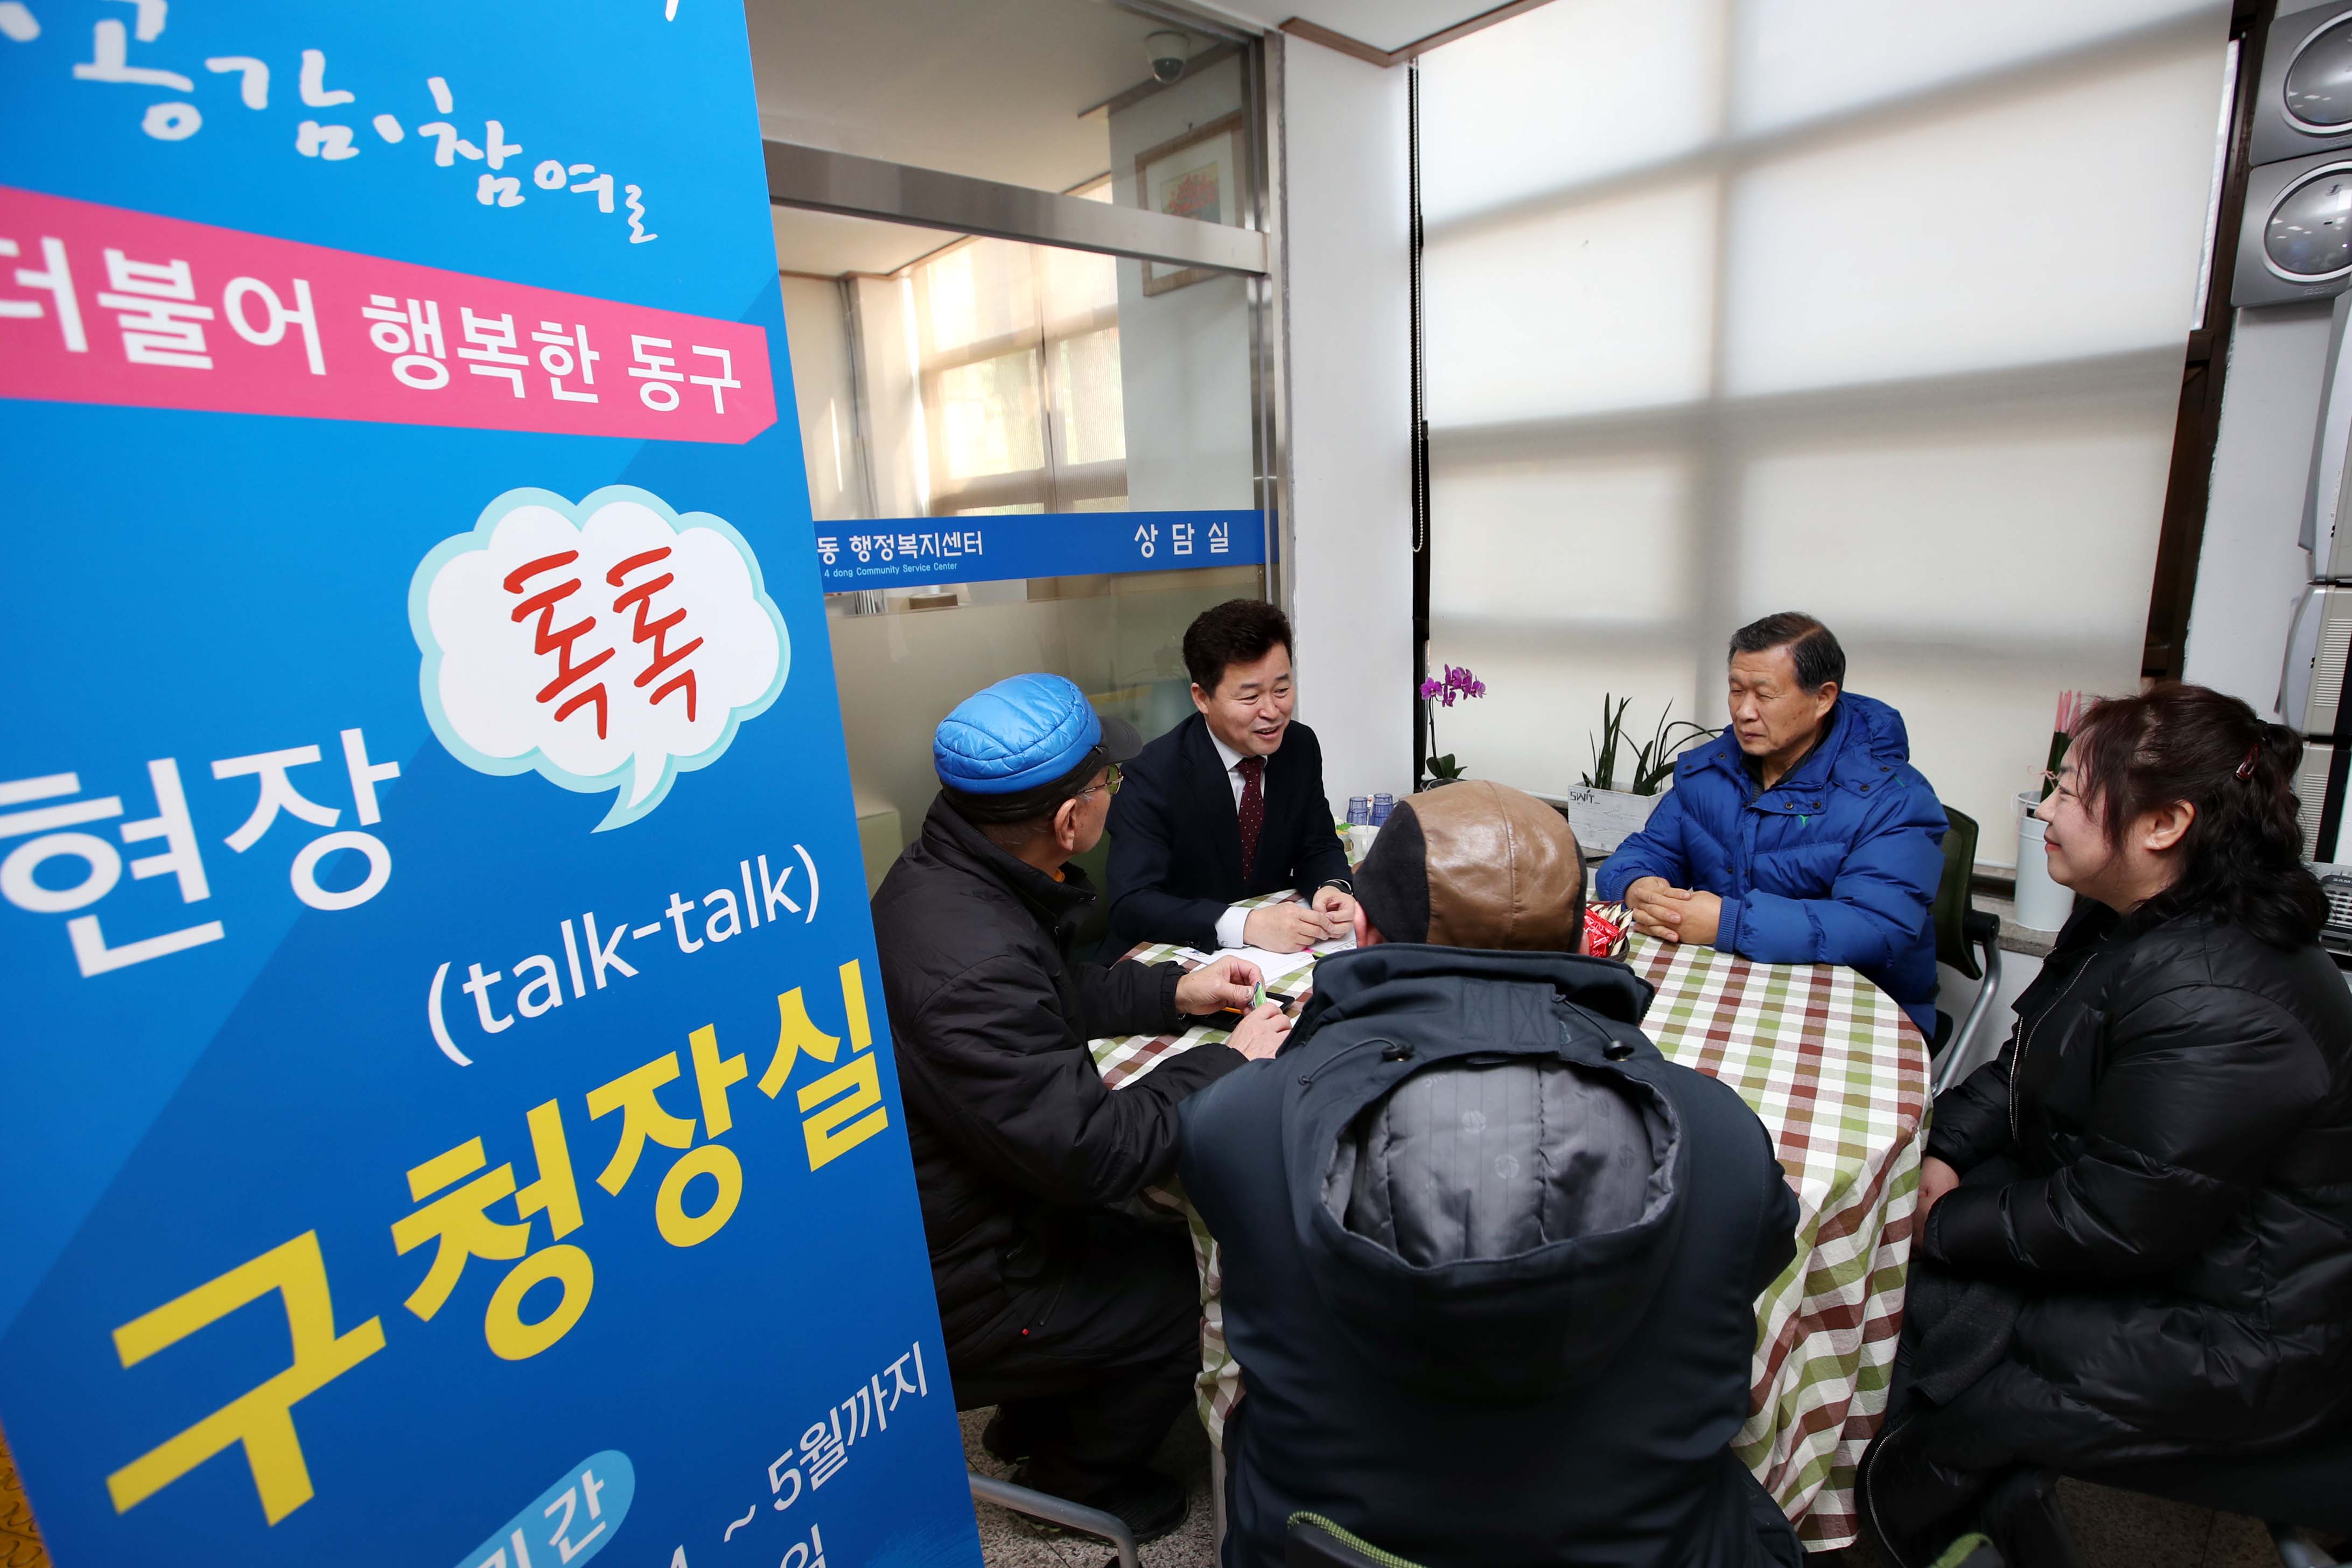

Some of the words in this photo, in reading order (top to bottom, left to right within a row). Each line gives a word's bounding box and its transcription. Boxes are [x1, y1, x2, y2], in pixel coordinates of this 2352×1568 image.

[0, 236, 327, 376] 더불어
[362, 294, 600, 404] 행복한
[628, 334, 742, 414] 동구
[817, 537, 840, 565] 동
[849, 530, 983, 563] 행정복지센터
[824, 569, 830, 577] 4
[833, 569, 853, 577] dong
[856, 565, 899, 575] Community
[902, 563, 930, 573] Service
[933, 562, 957, 571] Center
[0, 728, 401, 977] 현장
[428, 844, 820, 1067] (talk-talk)
[106, 958, 890, 1527] 구청장실
[768, 1341, 927, 1511] 5월까지
